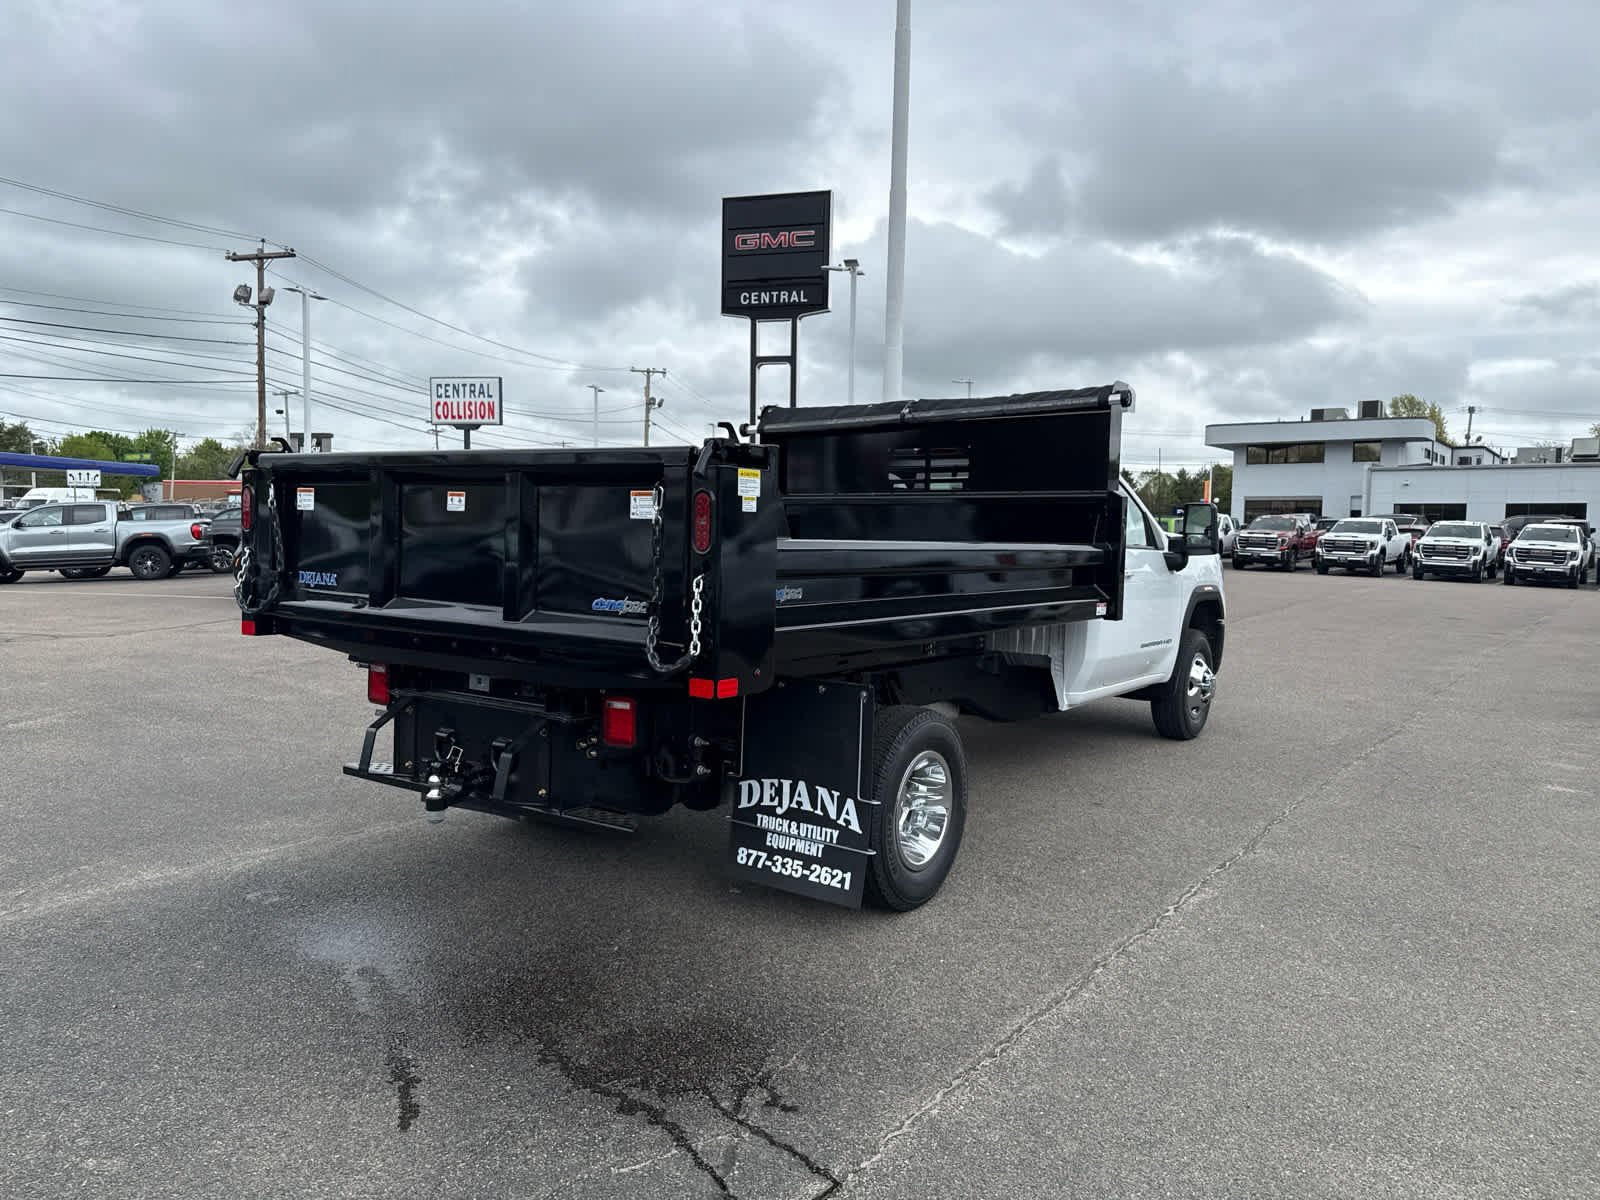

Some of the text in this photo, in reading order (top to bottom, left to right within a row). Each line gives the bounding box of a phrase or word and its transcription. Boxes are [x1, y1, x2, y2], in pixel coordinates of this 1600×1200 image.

[735, 230, 815, 250] GMC
[740, 290, 808, 304] CENTRAL
[436, 383, 493, 398] CENTRAL
[435, 401, 495, 420] COLLISION
[298, 570, 337, 587] DEJANA
[738, 778, 863, 834] DEJANA
[765, 832, 824, 858] EQUIPMENT
[737, 847, 852, 891] 877-335-2621
